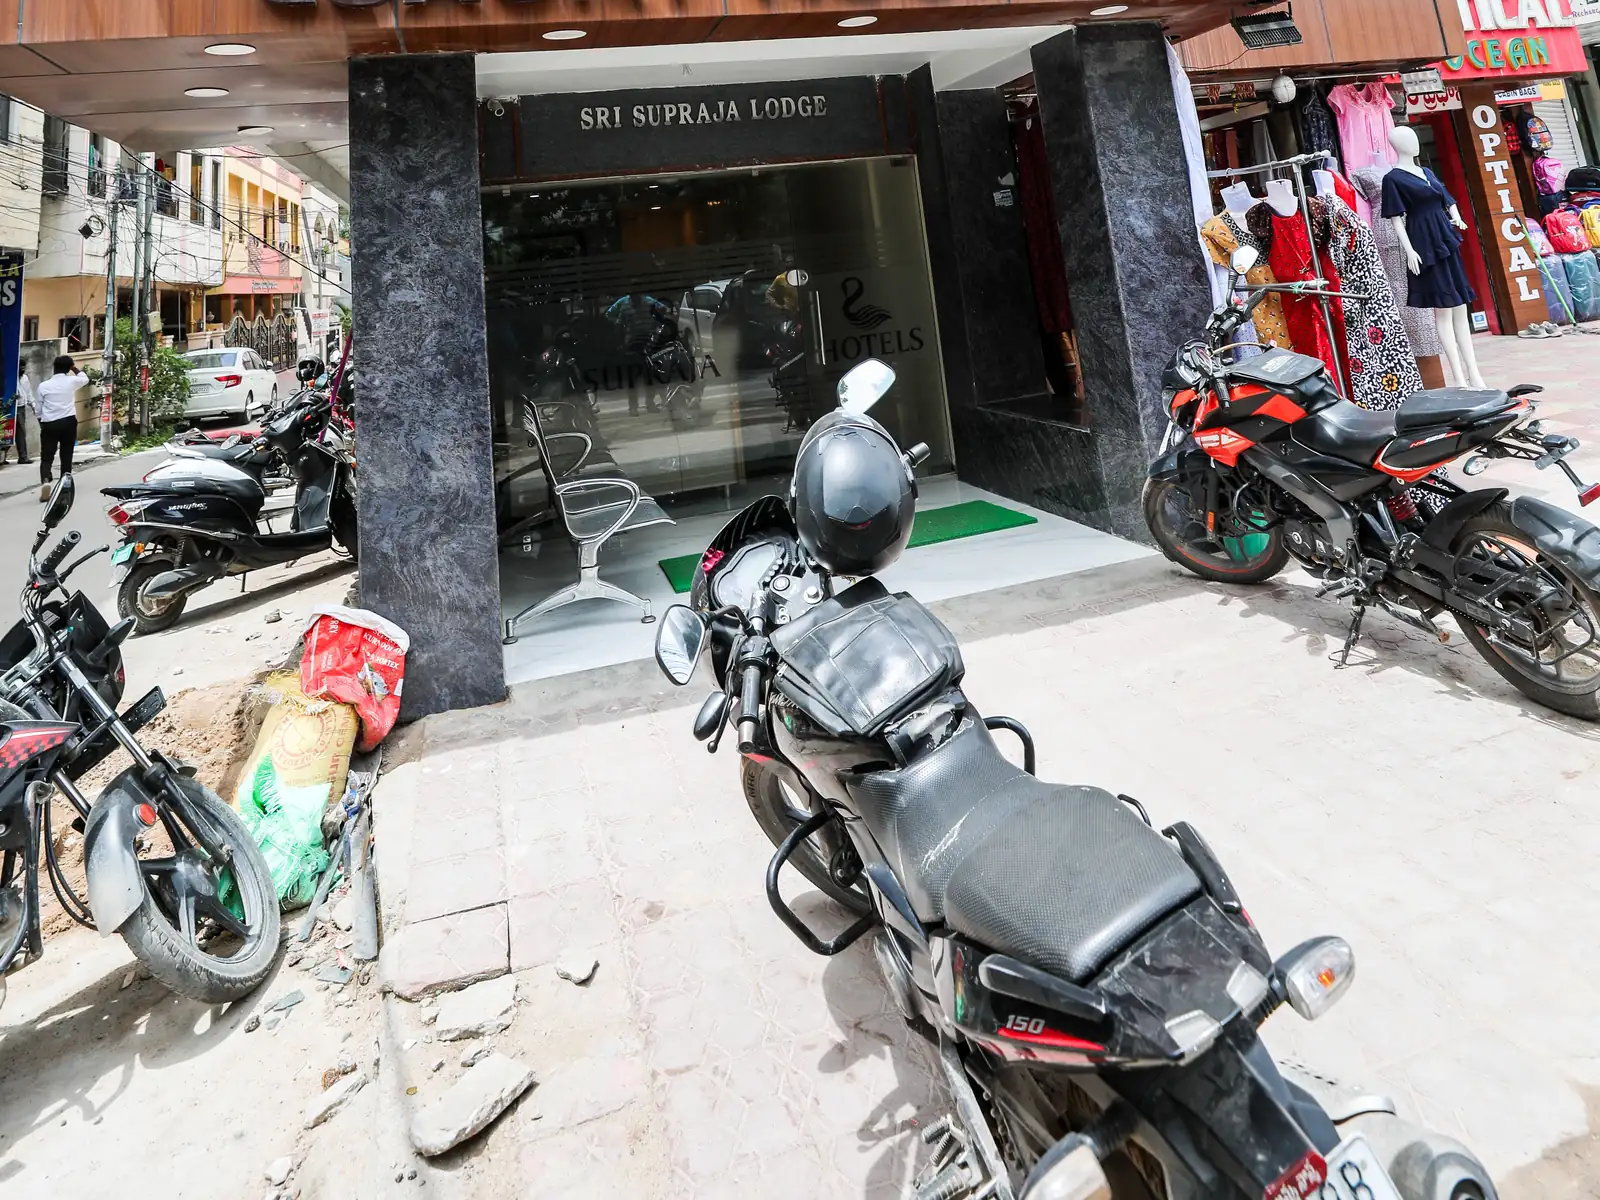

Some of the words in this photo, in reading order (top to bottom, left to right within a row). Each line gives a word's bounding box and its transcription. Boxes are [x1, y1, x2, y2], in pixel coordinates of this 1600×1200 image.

[1519, 86, 1537, 96] BAGS
[580, 106, 622, 130] SRI
[633, 100, 741, 127] SUPRAJA
[750, 95, 827, 120] LODGE
[1472, 105, 1540, 301] OPTICAL
[583, 355, 722, 392] SUPRAJA
[825, 328, 924, 362] HOTELS
[375, 656, 399, 670] SORTEX
[1005, 1014, 1046, 1035] 150
